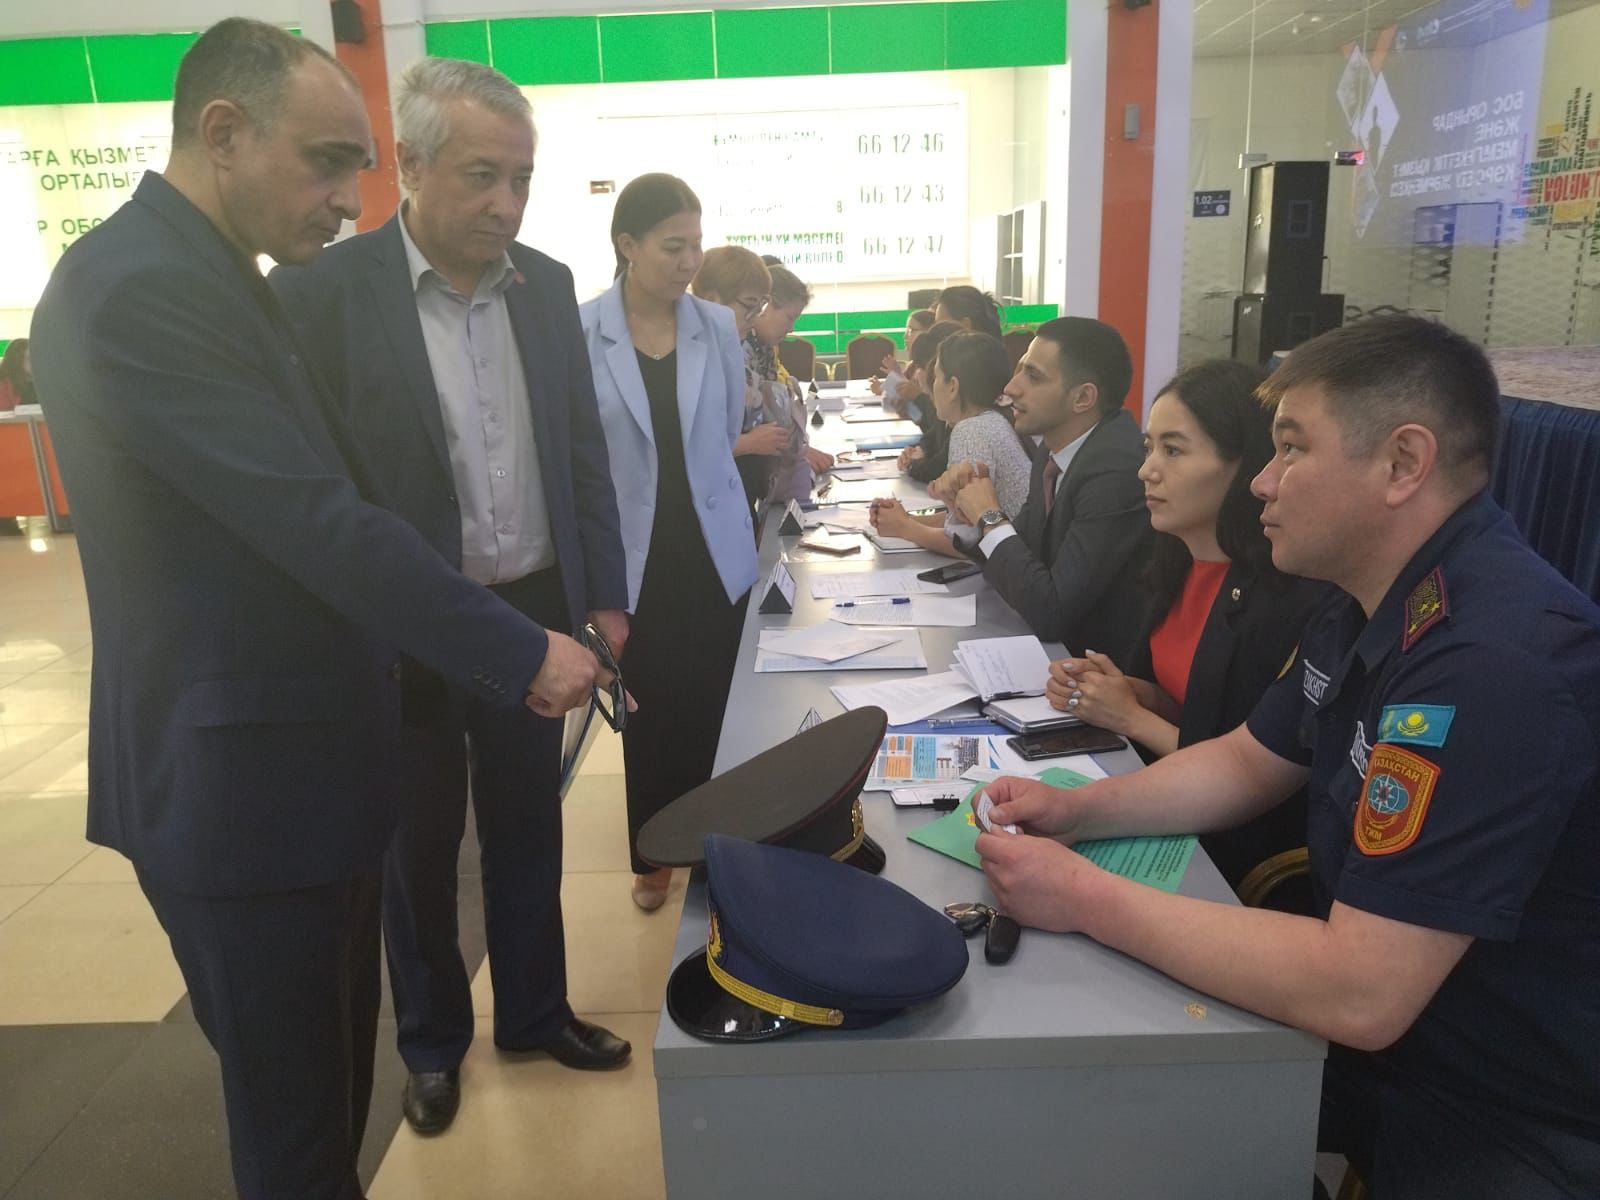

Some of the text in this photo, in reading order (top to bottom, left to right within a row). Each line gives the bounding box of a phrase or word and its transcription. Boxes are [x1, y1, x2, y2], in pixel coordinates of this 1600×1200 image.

[858, 134, 882, 154] 66
[893, 133, 911, 153] 12
[895, 184, 912, 203] 12
